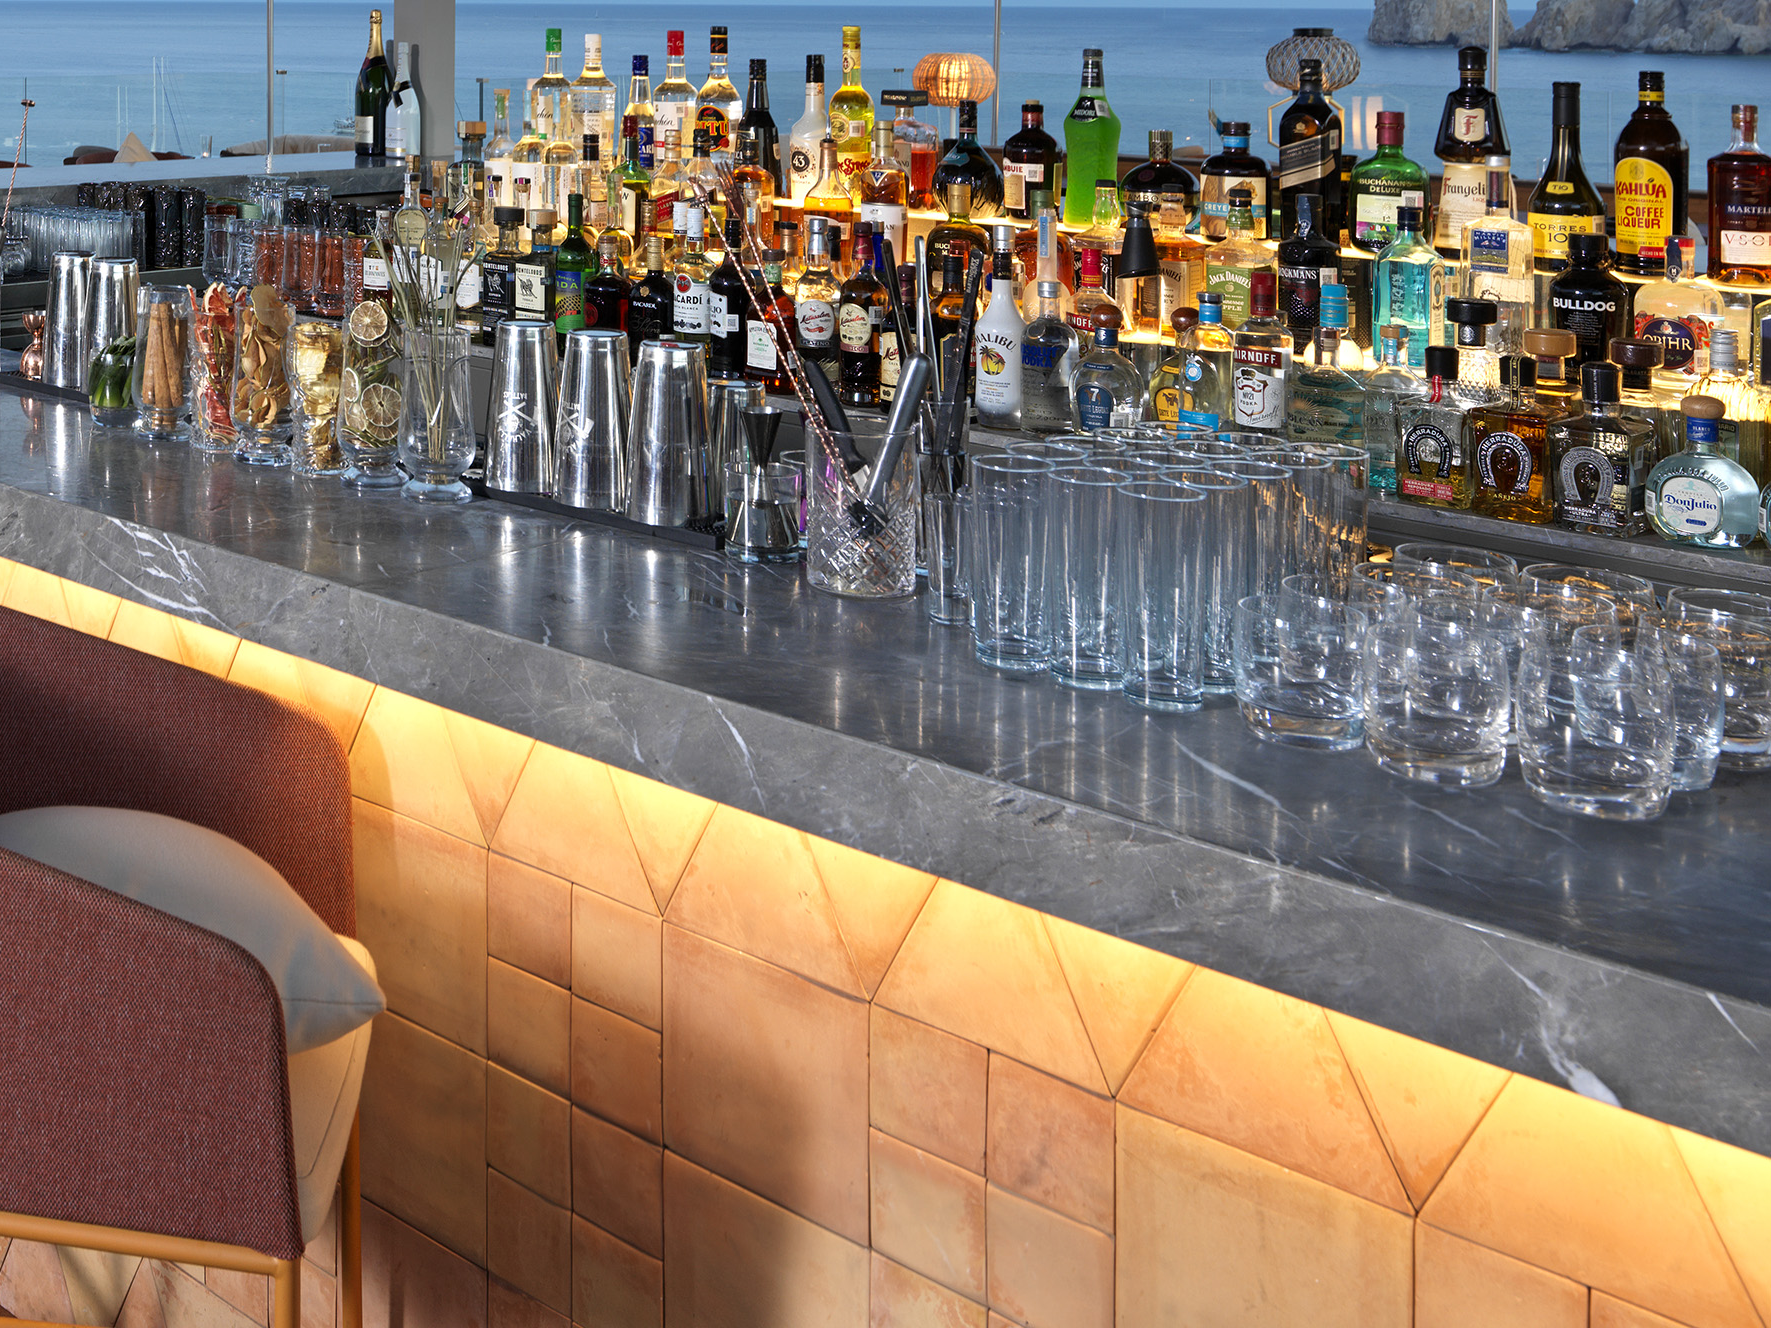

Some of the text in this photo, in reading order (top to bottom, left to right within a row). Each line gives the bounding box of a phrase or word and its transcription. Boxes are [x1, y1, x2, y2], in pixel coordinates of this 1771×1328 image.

[1463, 115, 1478, 135] F
[792, 155, 806, 168] 43
[1359, 178, 1412, 187] BUCHANAN'S
[1370, 185, 1400, 194] DELUXE
[1443, 177, 1485, 197] Frangeli
[1616, 178, 1666, 198] KAHLÚA
[1129, 193, 1158, 202] AMBO
[1204, 203, 1228, 212] CREYE
[1625, 206, 1664, 218] COFFEE
[1534, 223, 1586, 233] TORRES
[1618, 215, 1660, 229] LIQUEUR
[1548, 233, 1568, 243] 10
[1162, 268, 1182, 282] ANIEL'S
[1209, 270, 1251, 289] JACK DANIEL'S
[557, 281, 578, 289] IDA
[1553, 297, 1616, 312] BULLDOG
[975, 333, 1017, 352] MALIBU
[1090, 388, 1100, 402] 7
[1409, 429, 1447, 447] HERRADURA
[1482, 436, 1528, 455] HERRADURA
